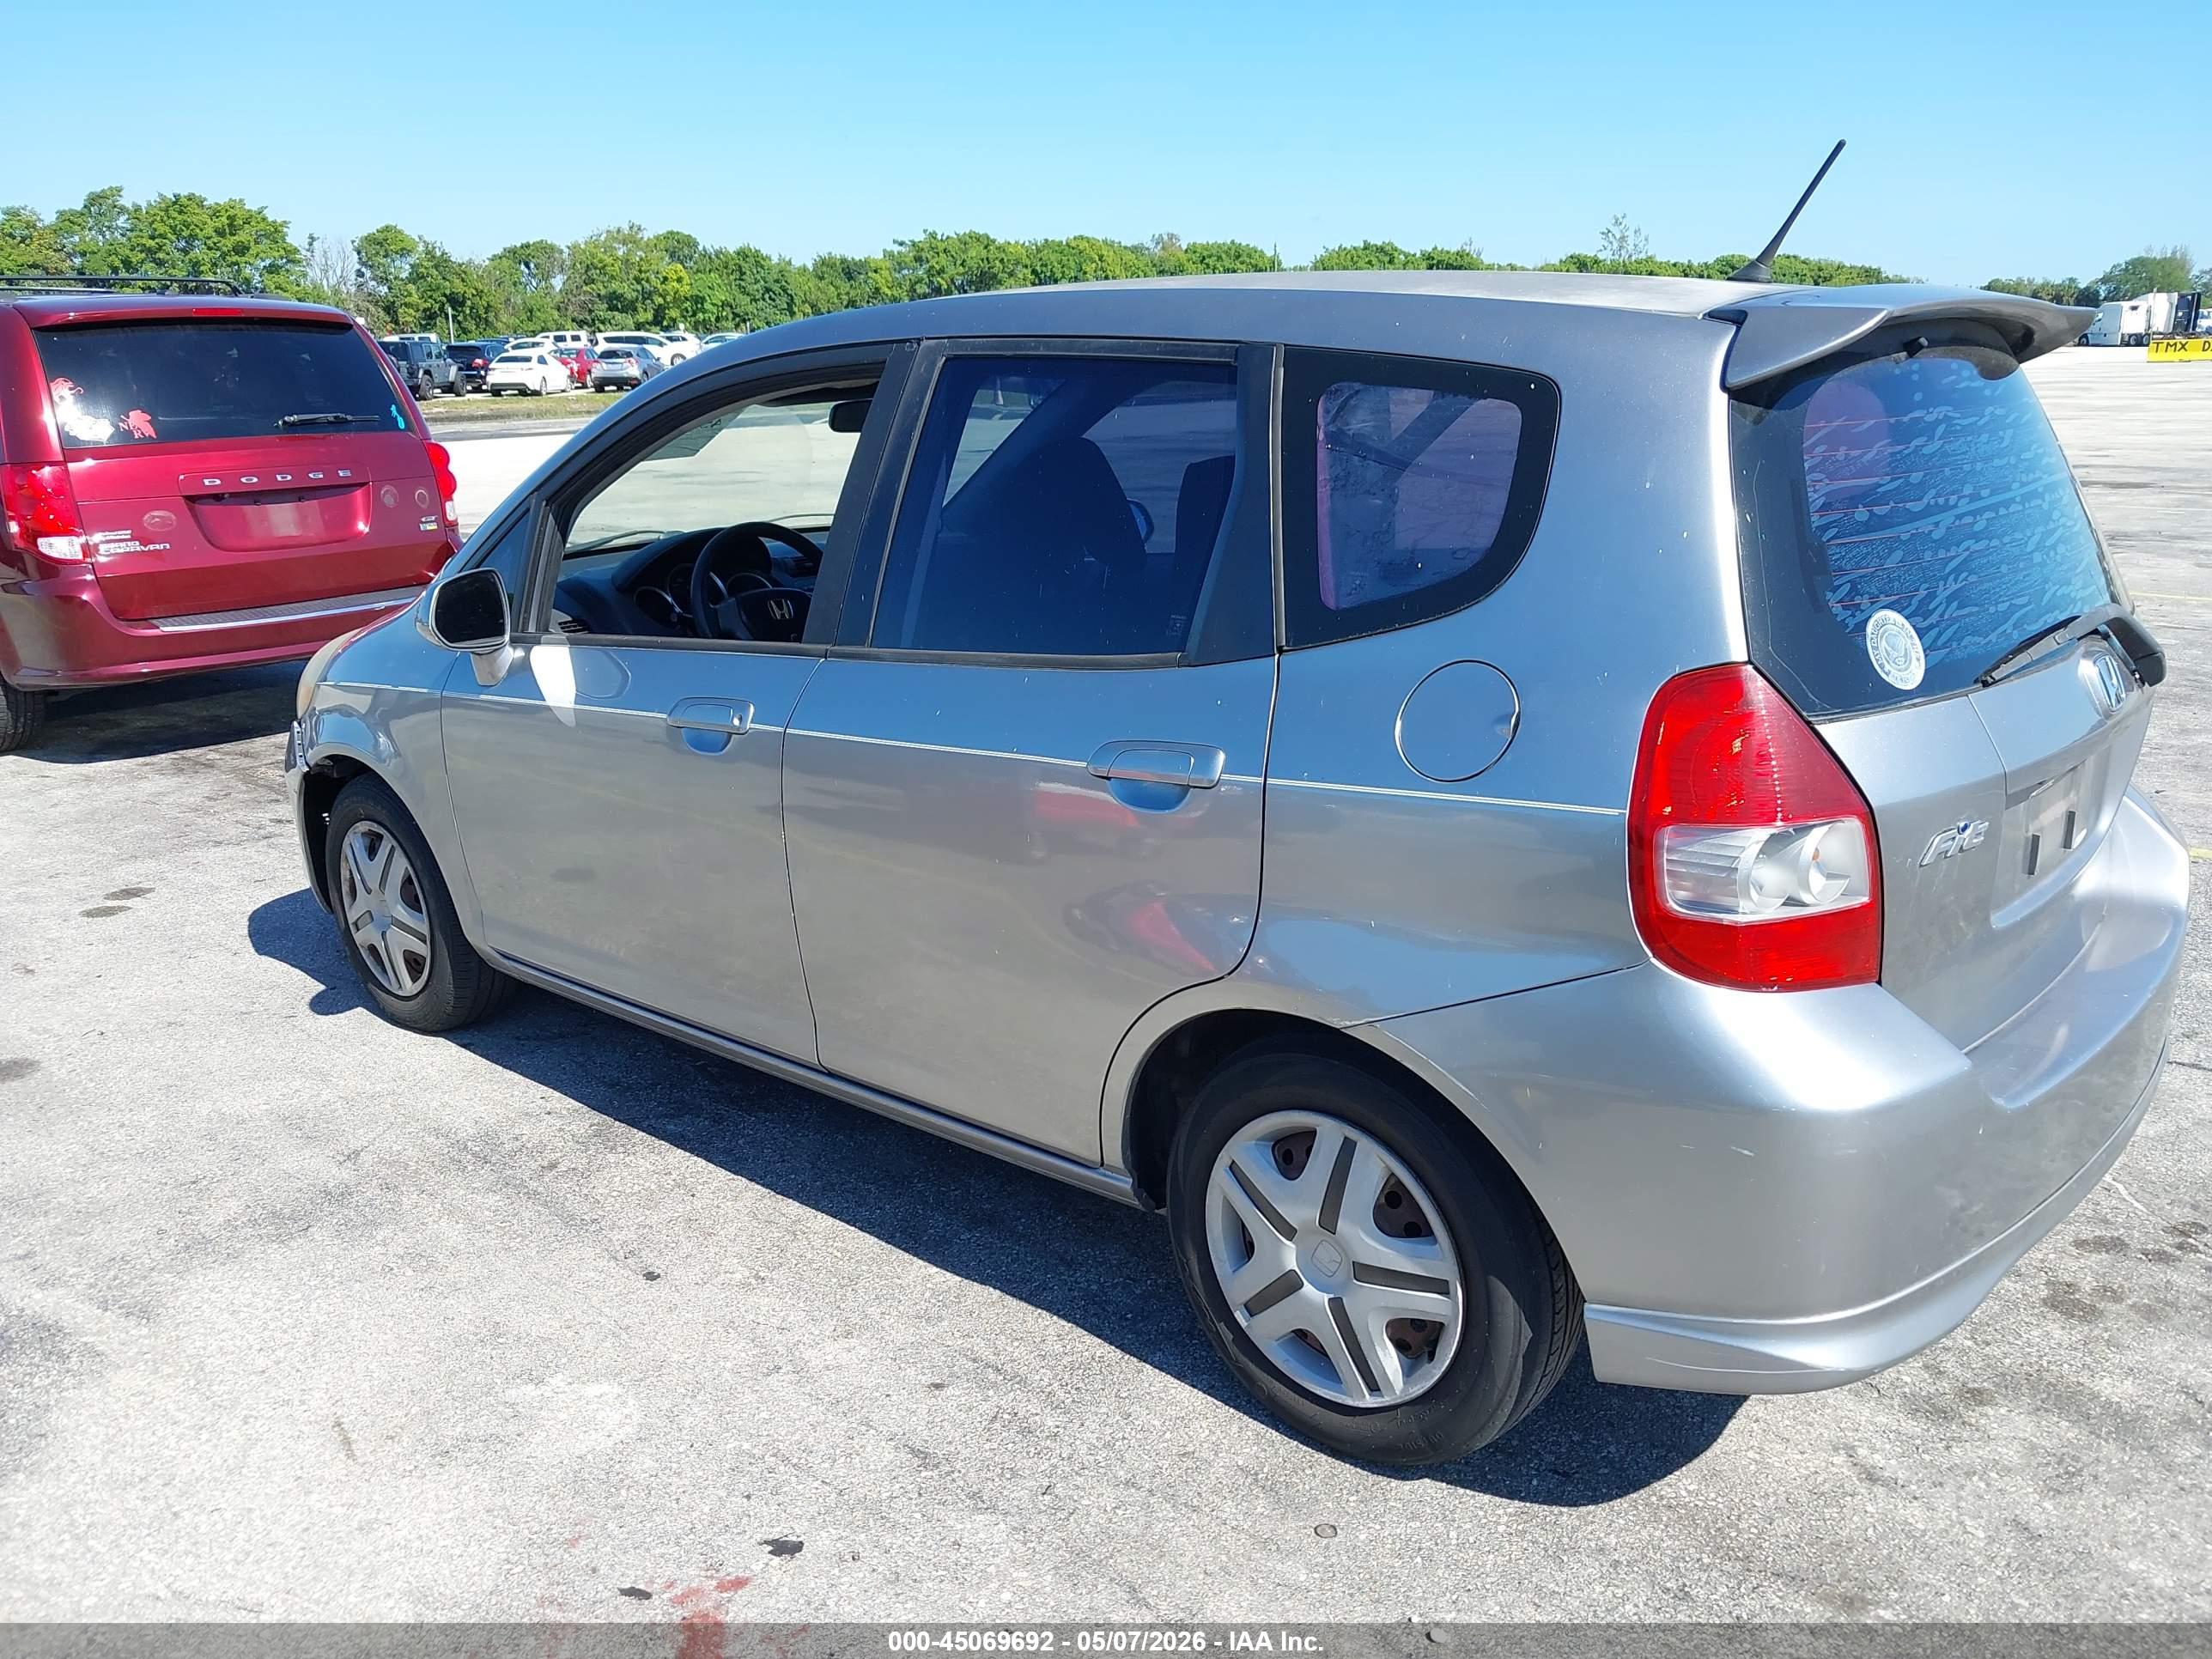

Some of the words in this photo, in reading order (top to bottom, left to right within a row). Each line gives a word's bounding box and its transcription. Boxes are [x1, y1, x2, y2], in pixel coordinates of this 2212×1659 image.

[2152, 341, 2189, 353] TMX
[2201, 340, 2212, 352] D
[203, 470, 352, 486] DODGE
